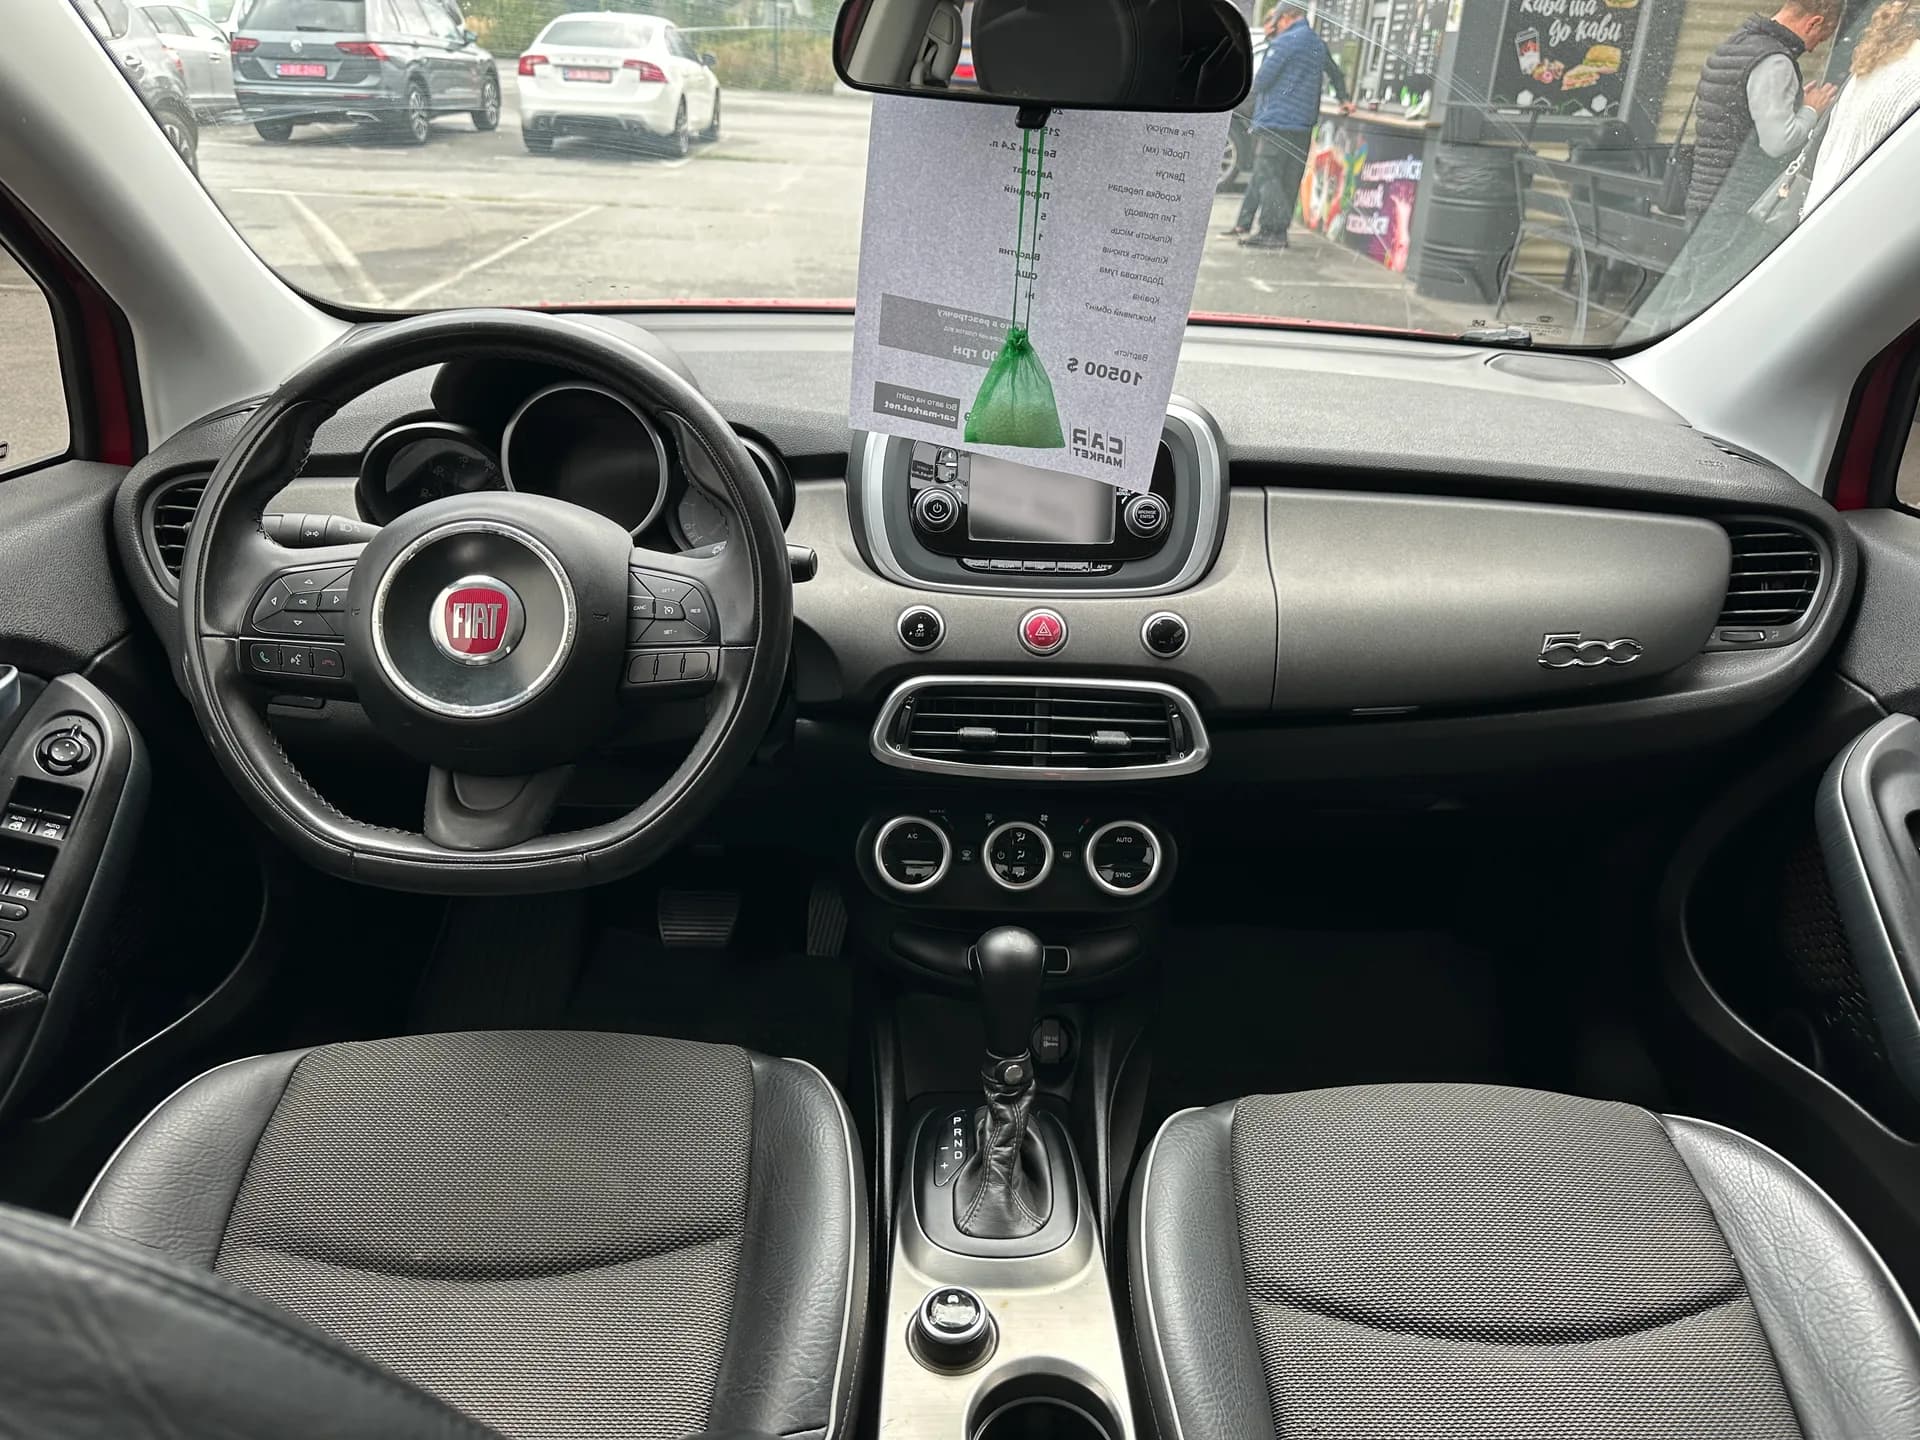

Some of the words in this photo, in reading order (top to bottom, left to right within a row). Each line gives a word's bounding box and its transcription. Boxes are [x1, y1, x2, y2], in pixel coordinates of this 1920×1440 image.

[1549, 20, 1572, 47] до
[1575, 14, 1622, 43] кави
[452, 602, 503, 640] FIAT
[1537, 631, 1644, 669] 500
[1114, 871, 1132, 879] SYNC
[953, 1128, 962, 1136] R
[954, 1139, 962, 1147] N
[954, 1151, 962, 1159] D
